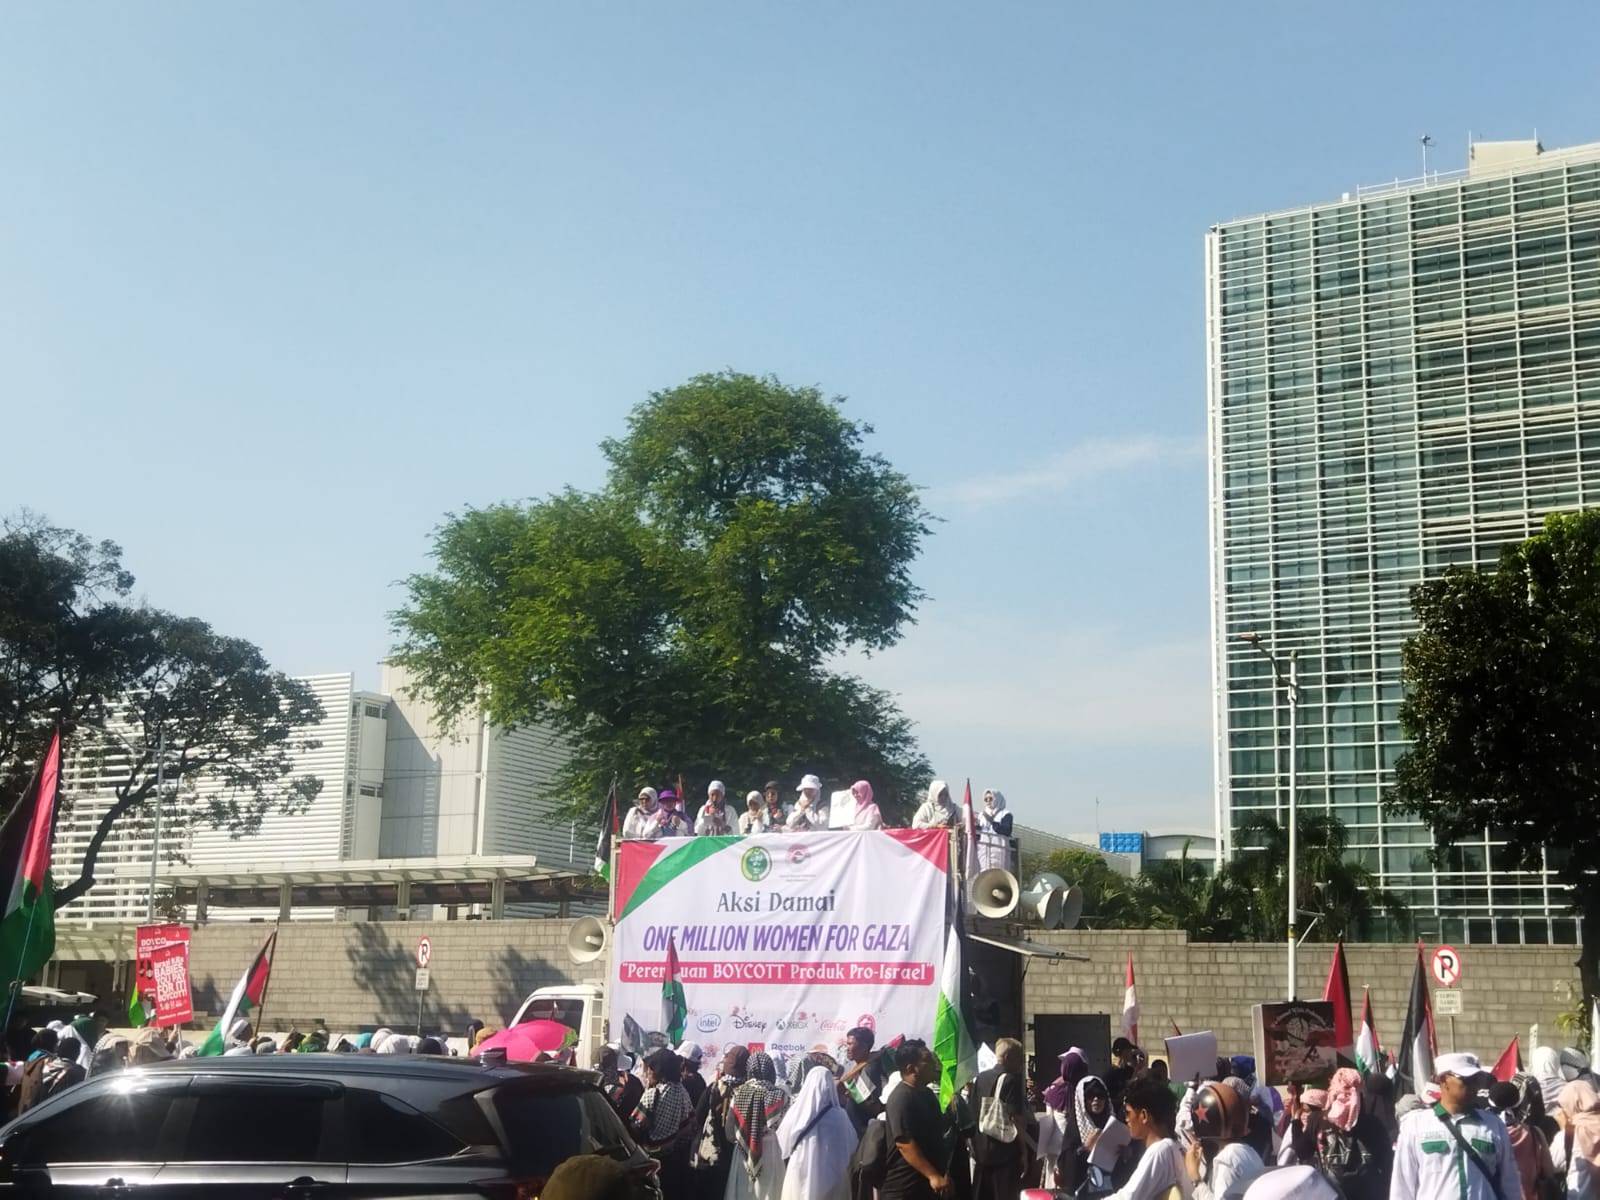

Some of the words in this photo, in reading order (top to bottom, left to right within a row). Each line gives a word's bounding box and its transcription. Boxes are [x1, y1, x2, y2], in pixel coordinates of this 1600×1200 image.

[716, 891, 761, 912] Aksi
[768, 889, 836, 912] Damai
[642, 925, 679, 951] ONE
[679, 925, 750, 951] MILLION
[752, 925, 823, 951] WOMEN
[825, 924, 860, 951] FOR
[862, 924, 910, 951] GAZA
[622, 962, 707, 979] "Peremuan
[713, 963, 785, 979] BOYCOTT
[790, 963, 845, 980] Produk
[699, 1016, 719, 1028] intel
[786, 1021, 808, 1031] XBOX
[771, 1042, 805, 1051] Reebok
